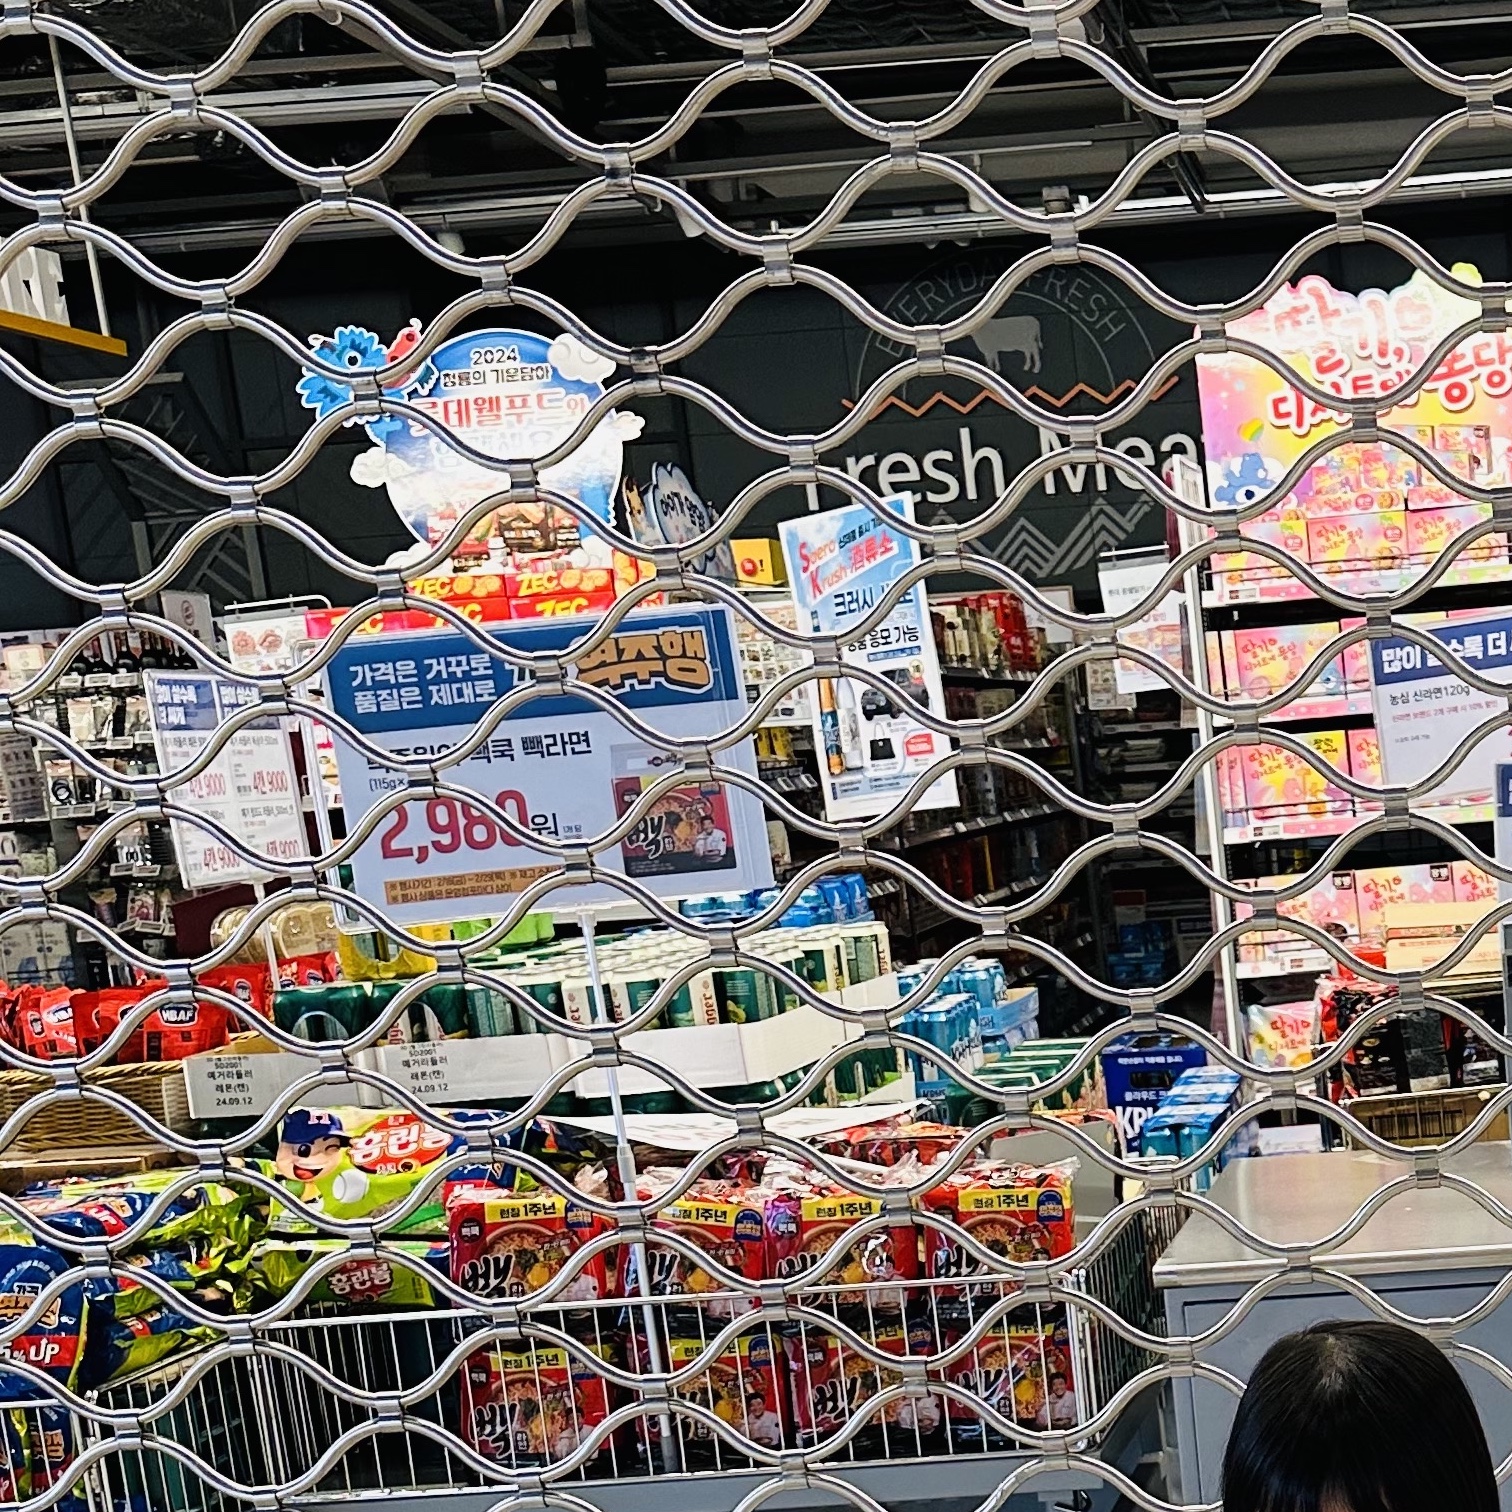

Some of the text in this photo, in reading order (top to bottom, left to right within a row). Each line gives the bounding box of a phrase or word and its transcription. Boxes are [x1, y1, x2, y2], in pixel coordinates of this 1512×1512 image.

[472, 348, 519, 365] 2024
[834, 585, 874, 616] 크러시
[1381, 645, 1422, 674] 많이
[1487, 633, 1506, 656] 더
[350, 656, 416, 686] 가격은
[426, 653, 493, 681] 거꾸로
[354, 682, 497, 714] 품질은 제대로
[522, 731, 593, 759] 빽라면
[162, 1008, 194, 1022] HBAF
[402, 1056, 447, 1068] 예거라들러
[207, 1070, 252, 1081] 예거라들러
[411, 1070, 444, 1082] 레몬(캔)
[216, 1083, 249, 1093] 레몬(캔)
[411, 1083, 448, 1094] 24.09.12
[216, 1097, 253, 1106] 24.09.12
[839, 1202, 872, 1216] 1주년
[997, 1194, 1029, 1208] 1주년
[524, 1201, 557, 1218] 1주년
[695, 1207, 728, 1223] 1주년
[328, 1263, 392, 1296] 홈런볼
[30, 1338, 60, 1364] UP
